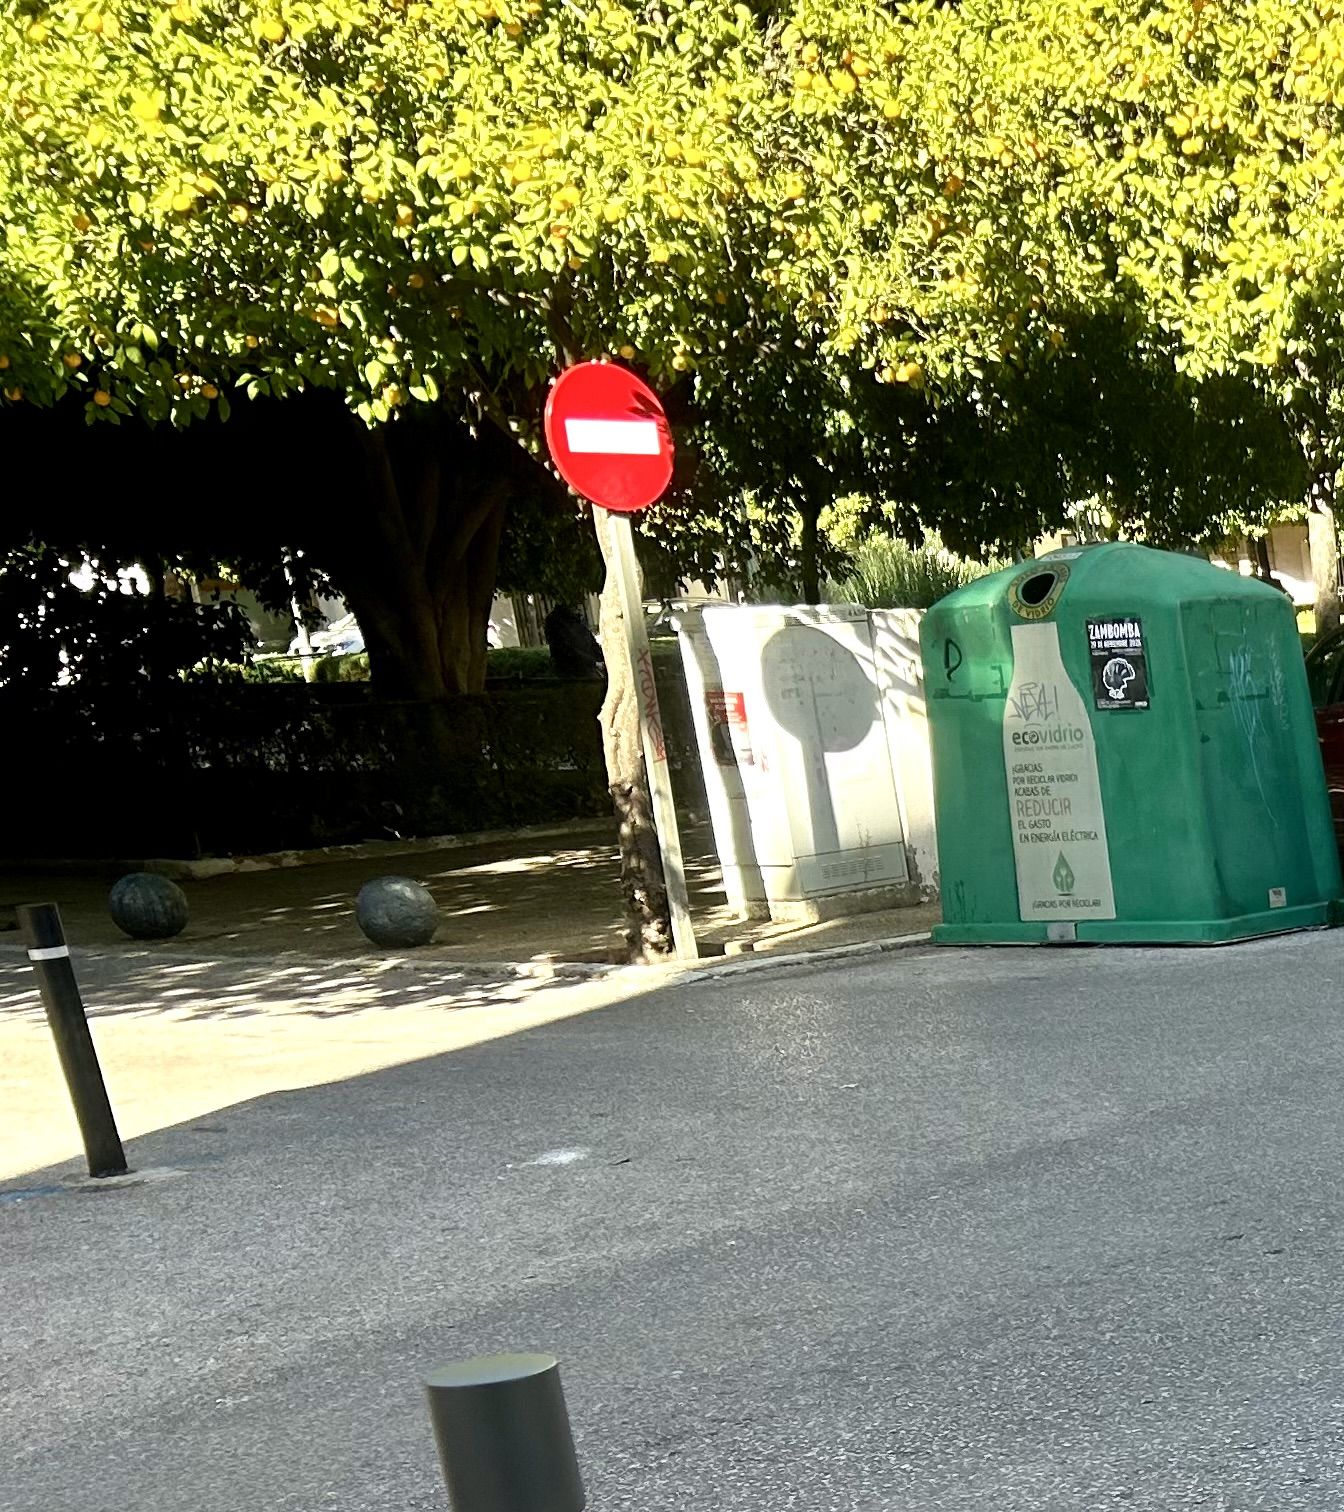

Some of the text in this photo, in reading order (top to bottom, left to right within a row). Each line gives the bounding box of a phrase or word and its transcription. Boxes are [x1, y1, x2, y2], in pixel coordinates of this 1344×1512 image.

[1025, 597, 1055, 617] VIDRIO
[1088, 623, 1140, 639] ZAMBOMBA
[1012, 723, 1084, 745] ecovidrio
[1041, 785, 1051, 796] DE
[1016, 797, 1072, 817] REDUCIR
[1018, 818, 1051, 830] EL GASTO
